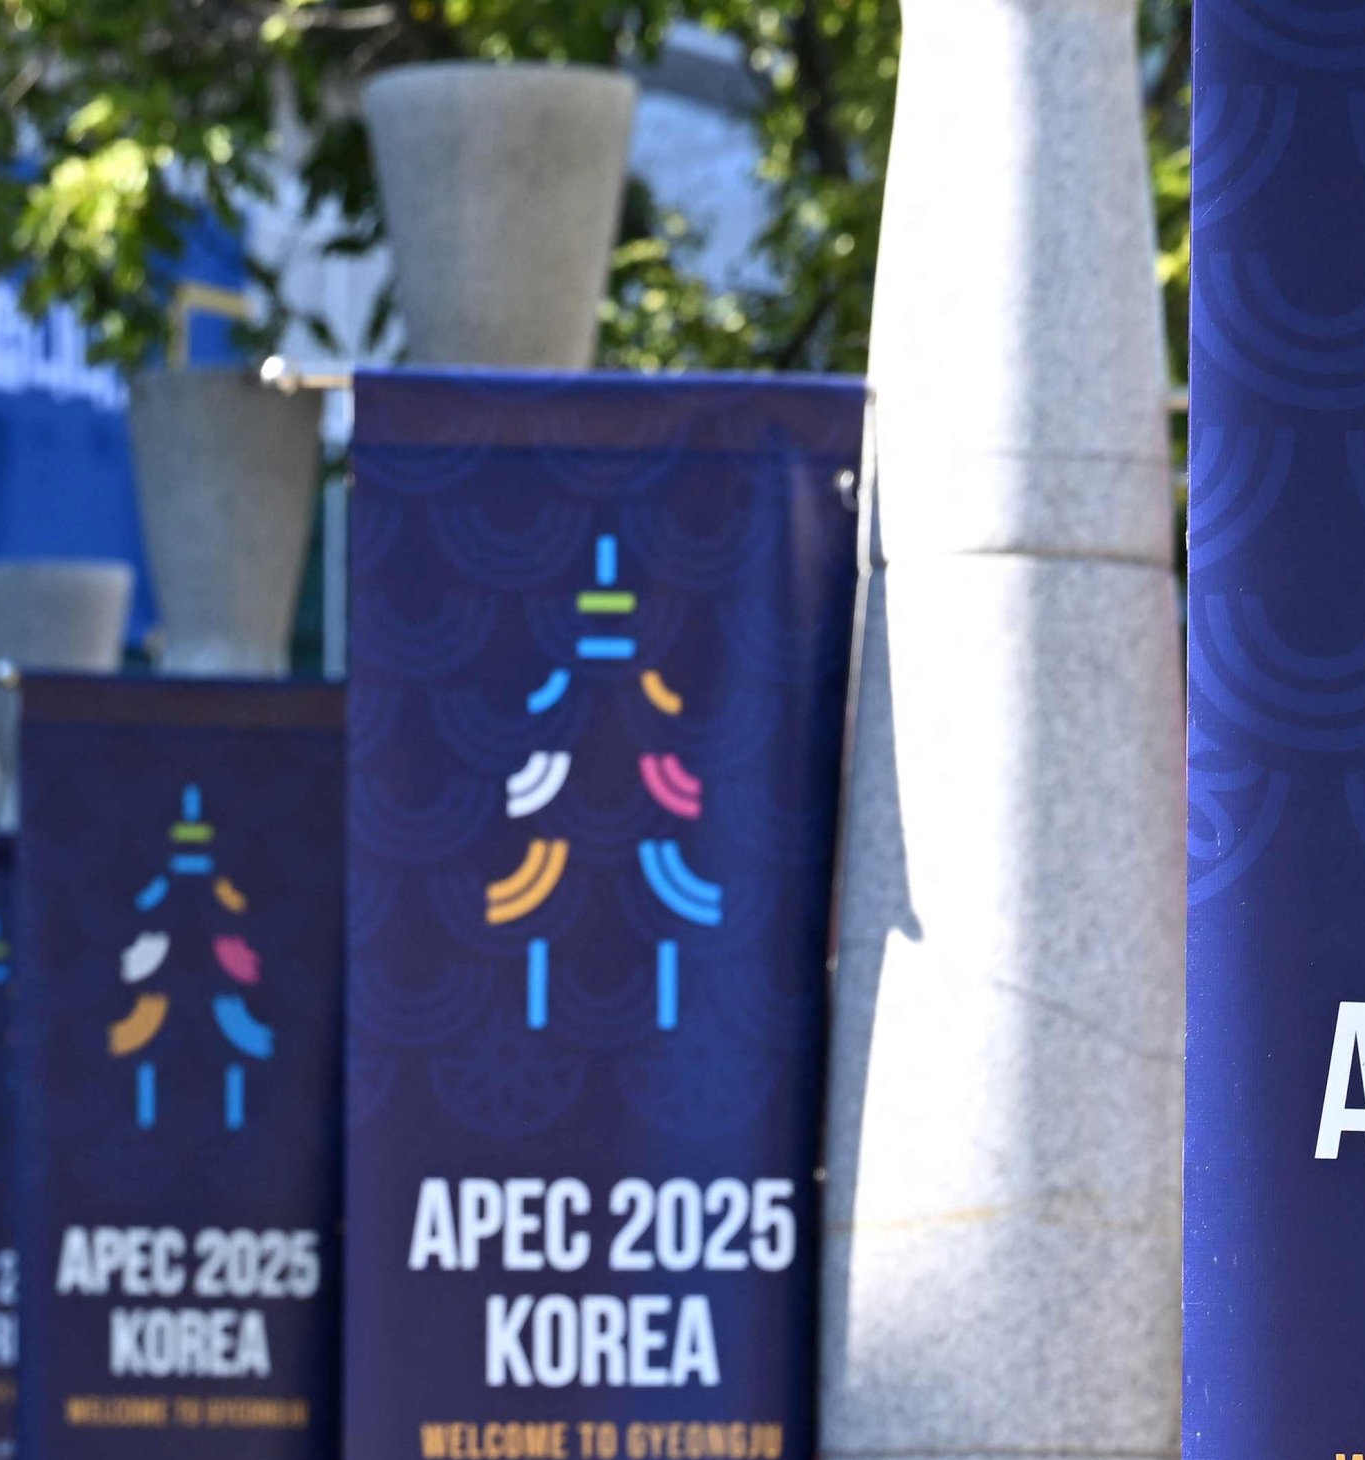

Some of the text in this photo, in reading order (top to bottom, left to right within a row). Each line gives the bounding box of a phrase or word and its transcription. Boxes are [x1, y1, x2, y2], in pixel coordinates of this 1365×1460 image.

[56, 1226, 321, 1299] APEC 2025
[408, 1177, 797, 1273] APEC 2025
[109, 1308, 272, 1379] KOREA
[485, 1294, 723, 1389] KOREA
